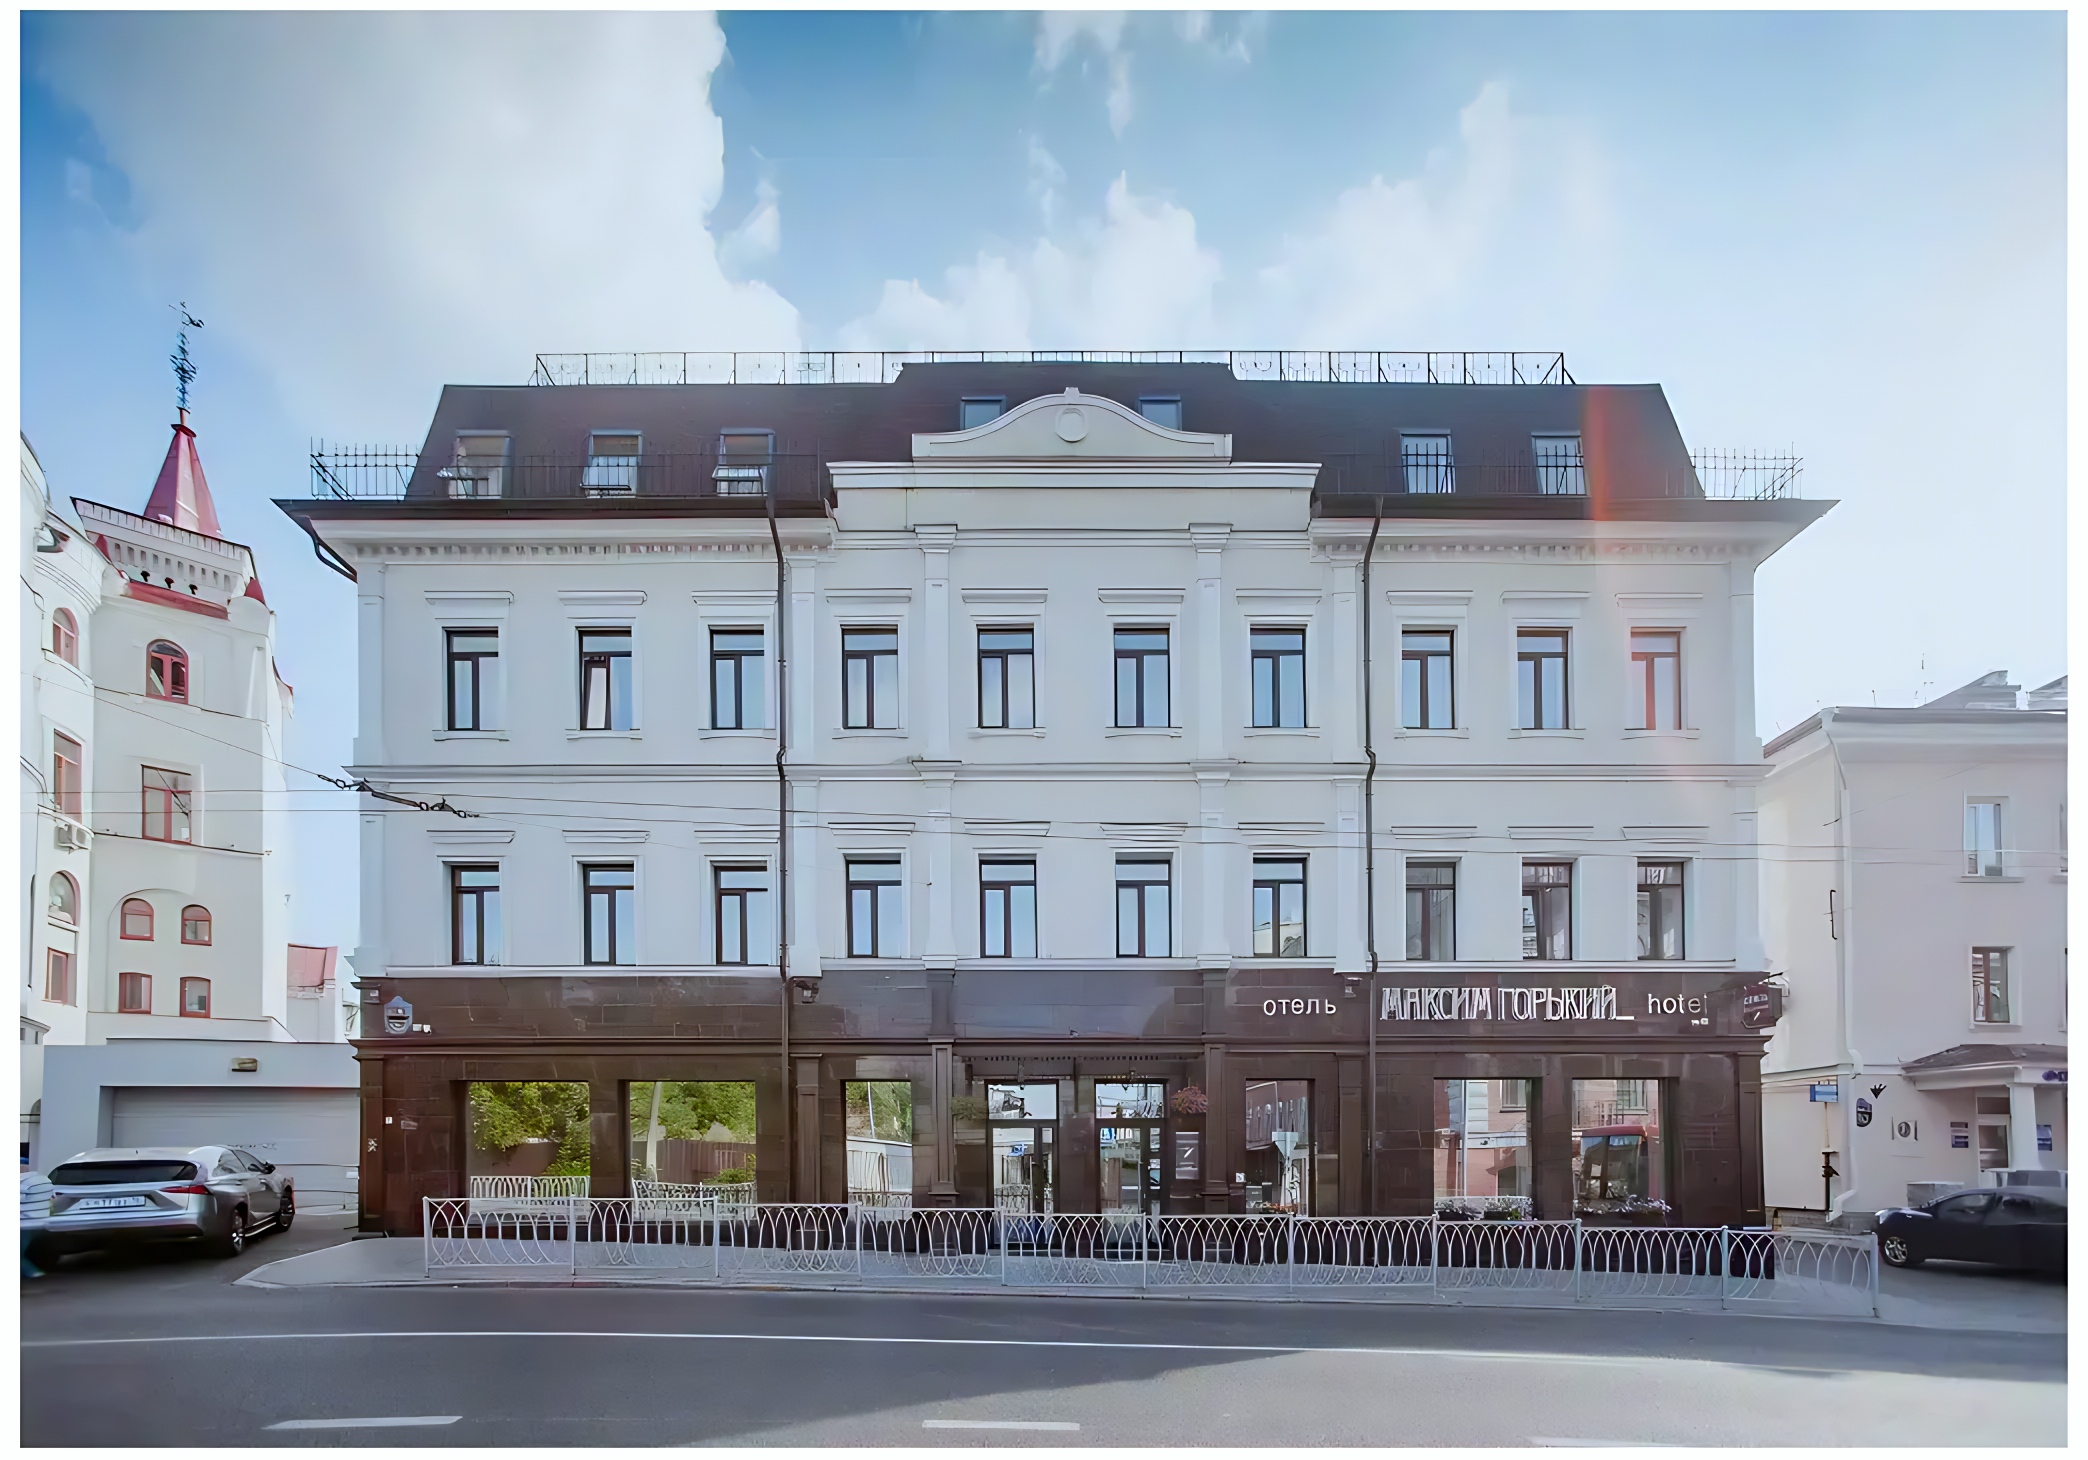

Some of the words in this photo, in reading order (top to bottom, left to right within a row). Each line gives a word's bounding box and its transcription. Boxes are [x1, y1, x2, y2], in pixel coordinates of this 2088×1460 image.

[1263, 998, 1337, 1016] отель
[1380, 987, 1492, 1021] МАКСИМ
[1647, 993, 1708, 1015] hotel
